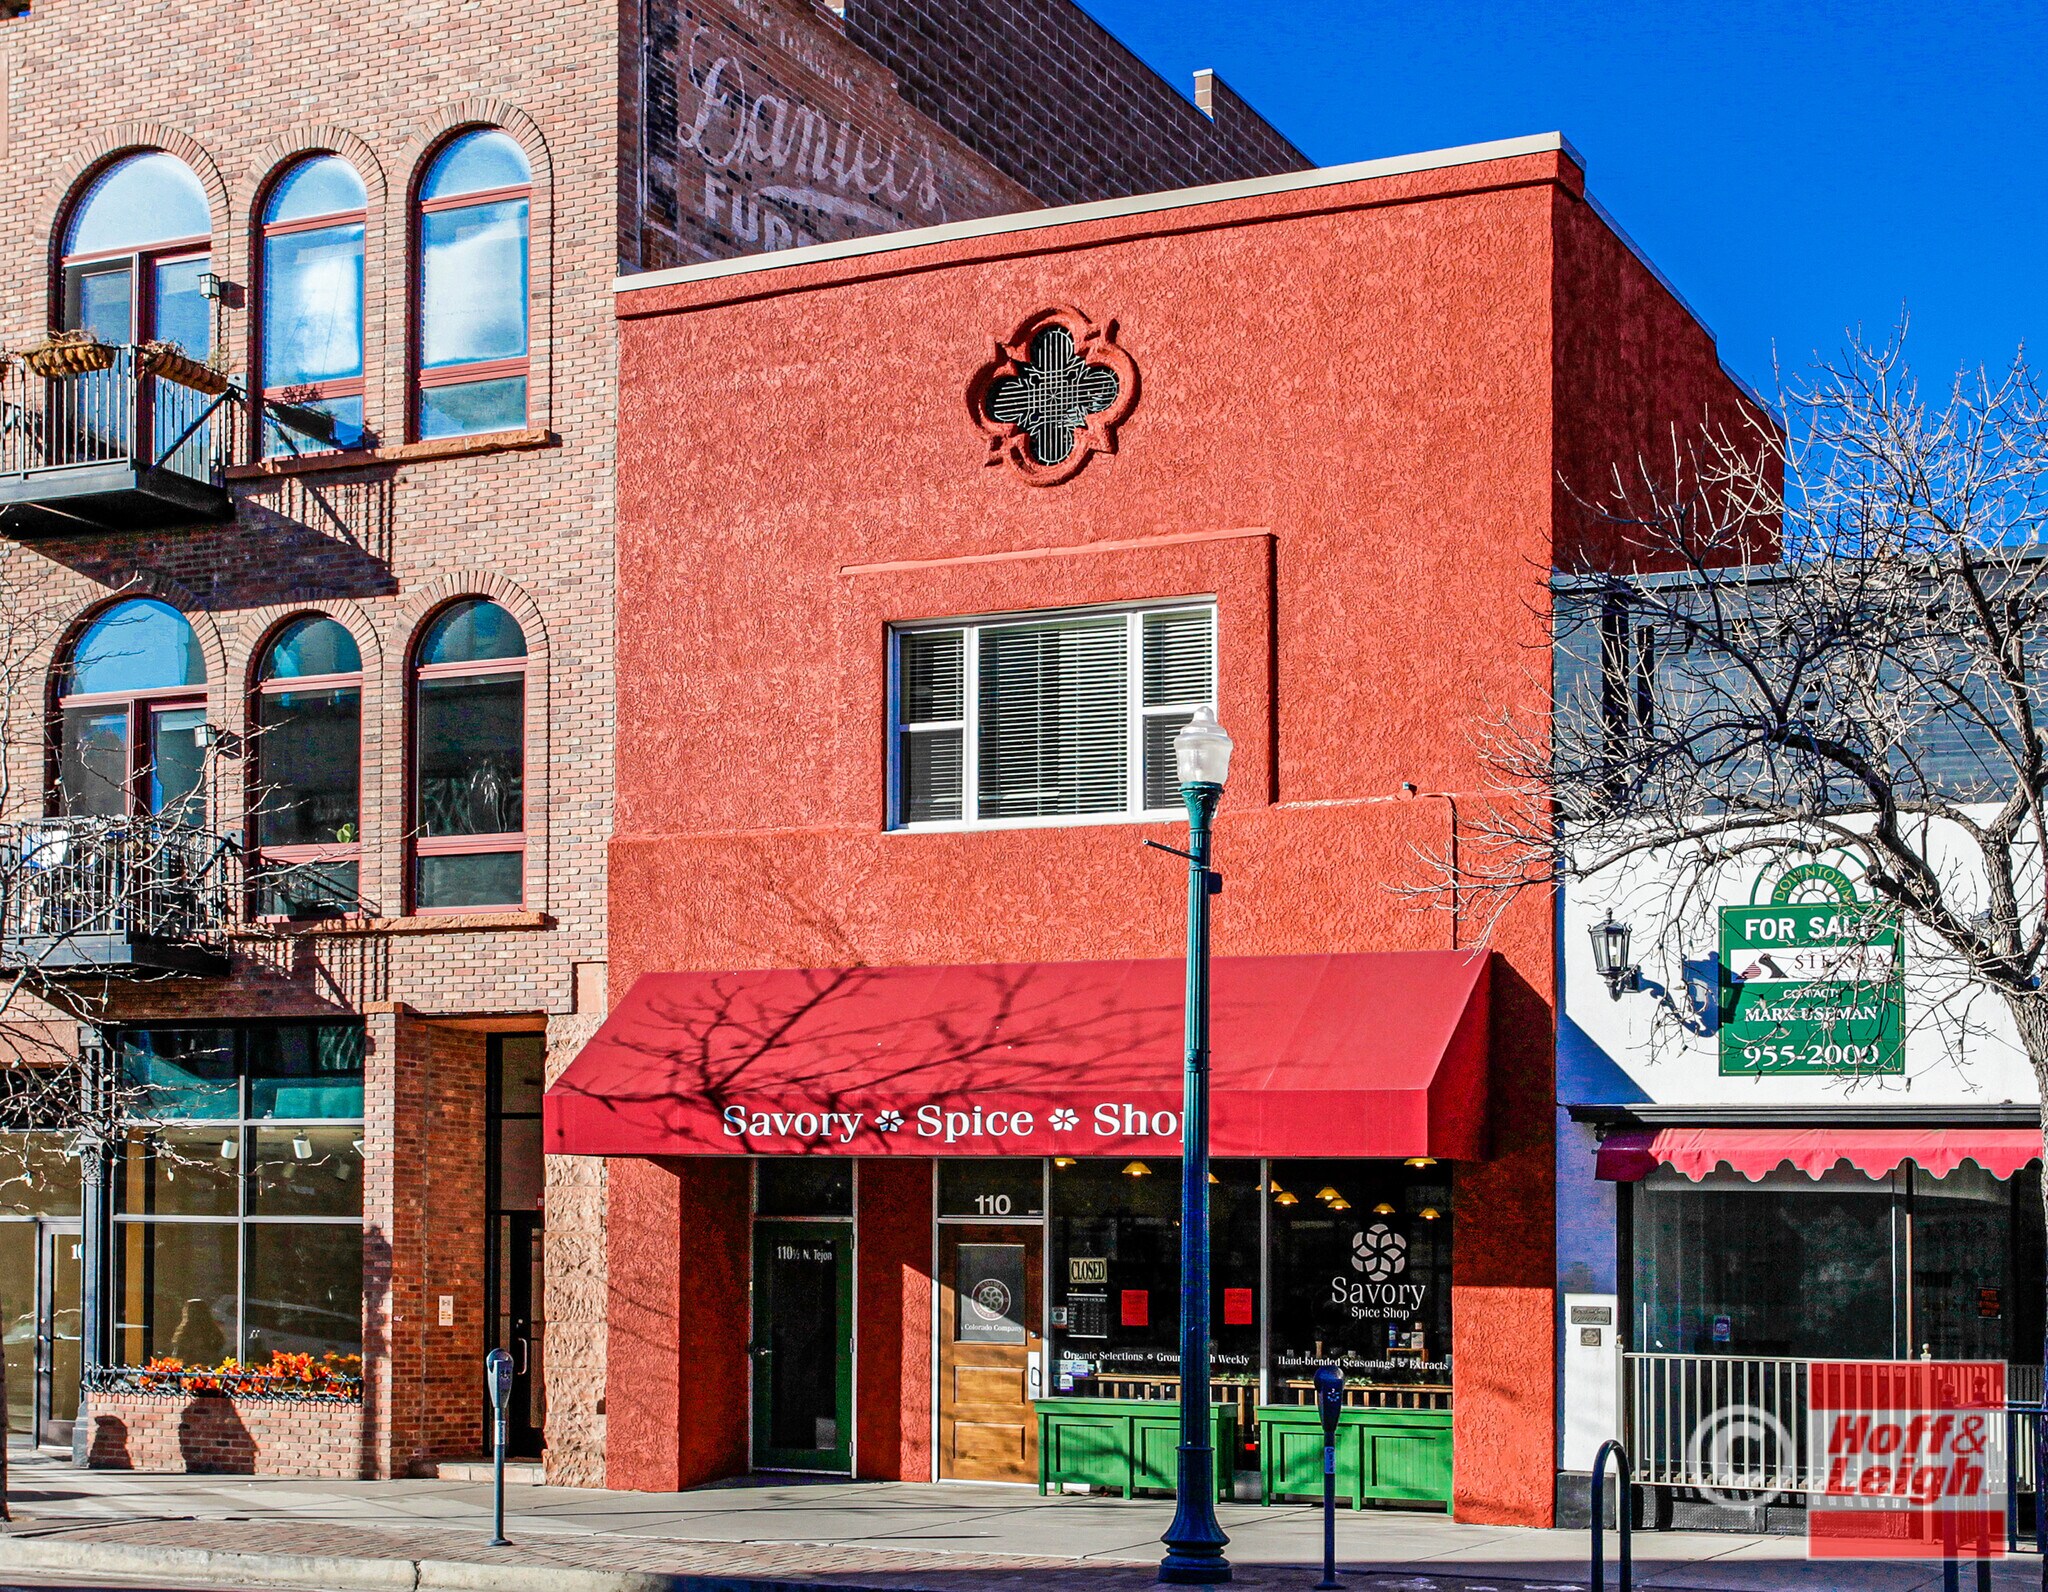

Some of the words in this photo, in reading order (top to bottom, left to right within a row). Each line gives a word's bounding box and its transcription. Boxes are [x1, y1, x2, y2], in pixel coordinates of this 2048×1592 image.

[704, 172, 815, 252] FUR
[1774, 866, 1854, 901] DOWNTOWN
[1745, 917, 1796, 940] FOR
[1744, 1007, 1797, 1022] MARK
[1743, 1043, 1880, 1068] 955-2000
[722, 1104, 864, 1144] Savory
[916, 1103, 1034, 1144] Spice
[1093, 1102, 1184, 1144] Sho
[974, 1194, 1012, 1215] 110
[803, 1249, 811, 1260] N.
[814, 1249, 833, 1262] Tejon
[1071, 1260, 1105, 1280] CLOSED
[1331, 1276, 1427, 1311] Savory
[1351, 1306, 1381, 1320] Spice
[1383, 1306, 1410, 1321] Shop
[964, 1323, 993, 1332] Colorado
[993, 1324, 1022, 1333] Company
[1063, 1350, 1098, 1361] Organic
[1099, 1351, 1144, 1362] Selections
[1216, 1353, 1250, 1366] Weekly
[1277, 1356, 1341, 1368] Hand-blended
[1342, 1357, 1395, 1369] Seasonings
[1409, 1359, 1449, 1370] Extracts
